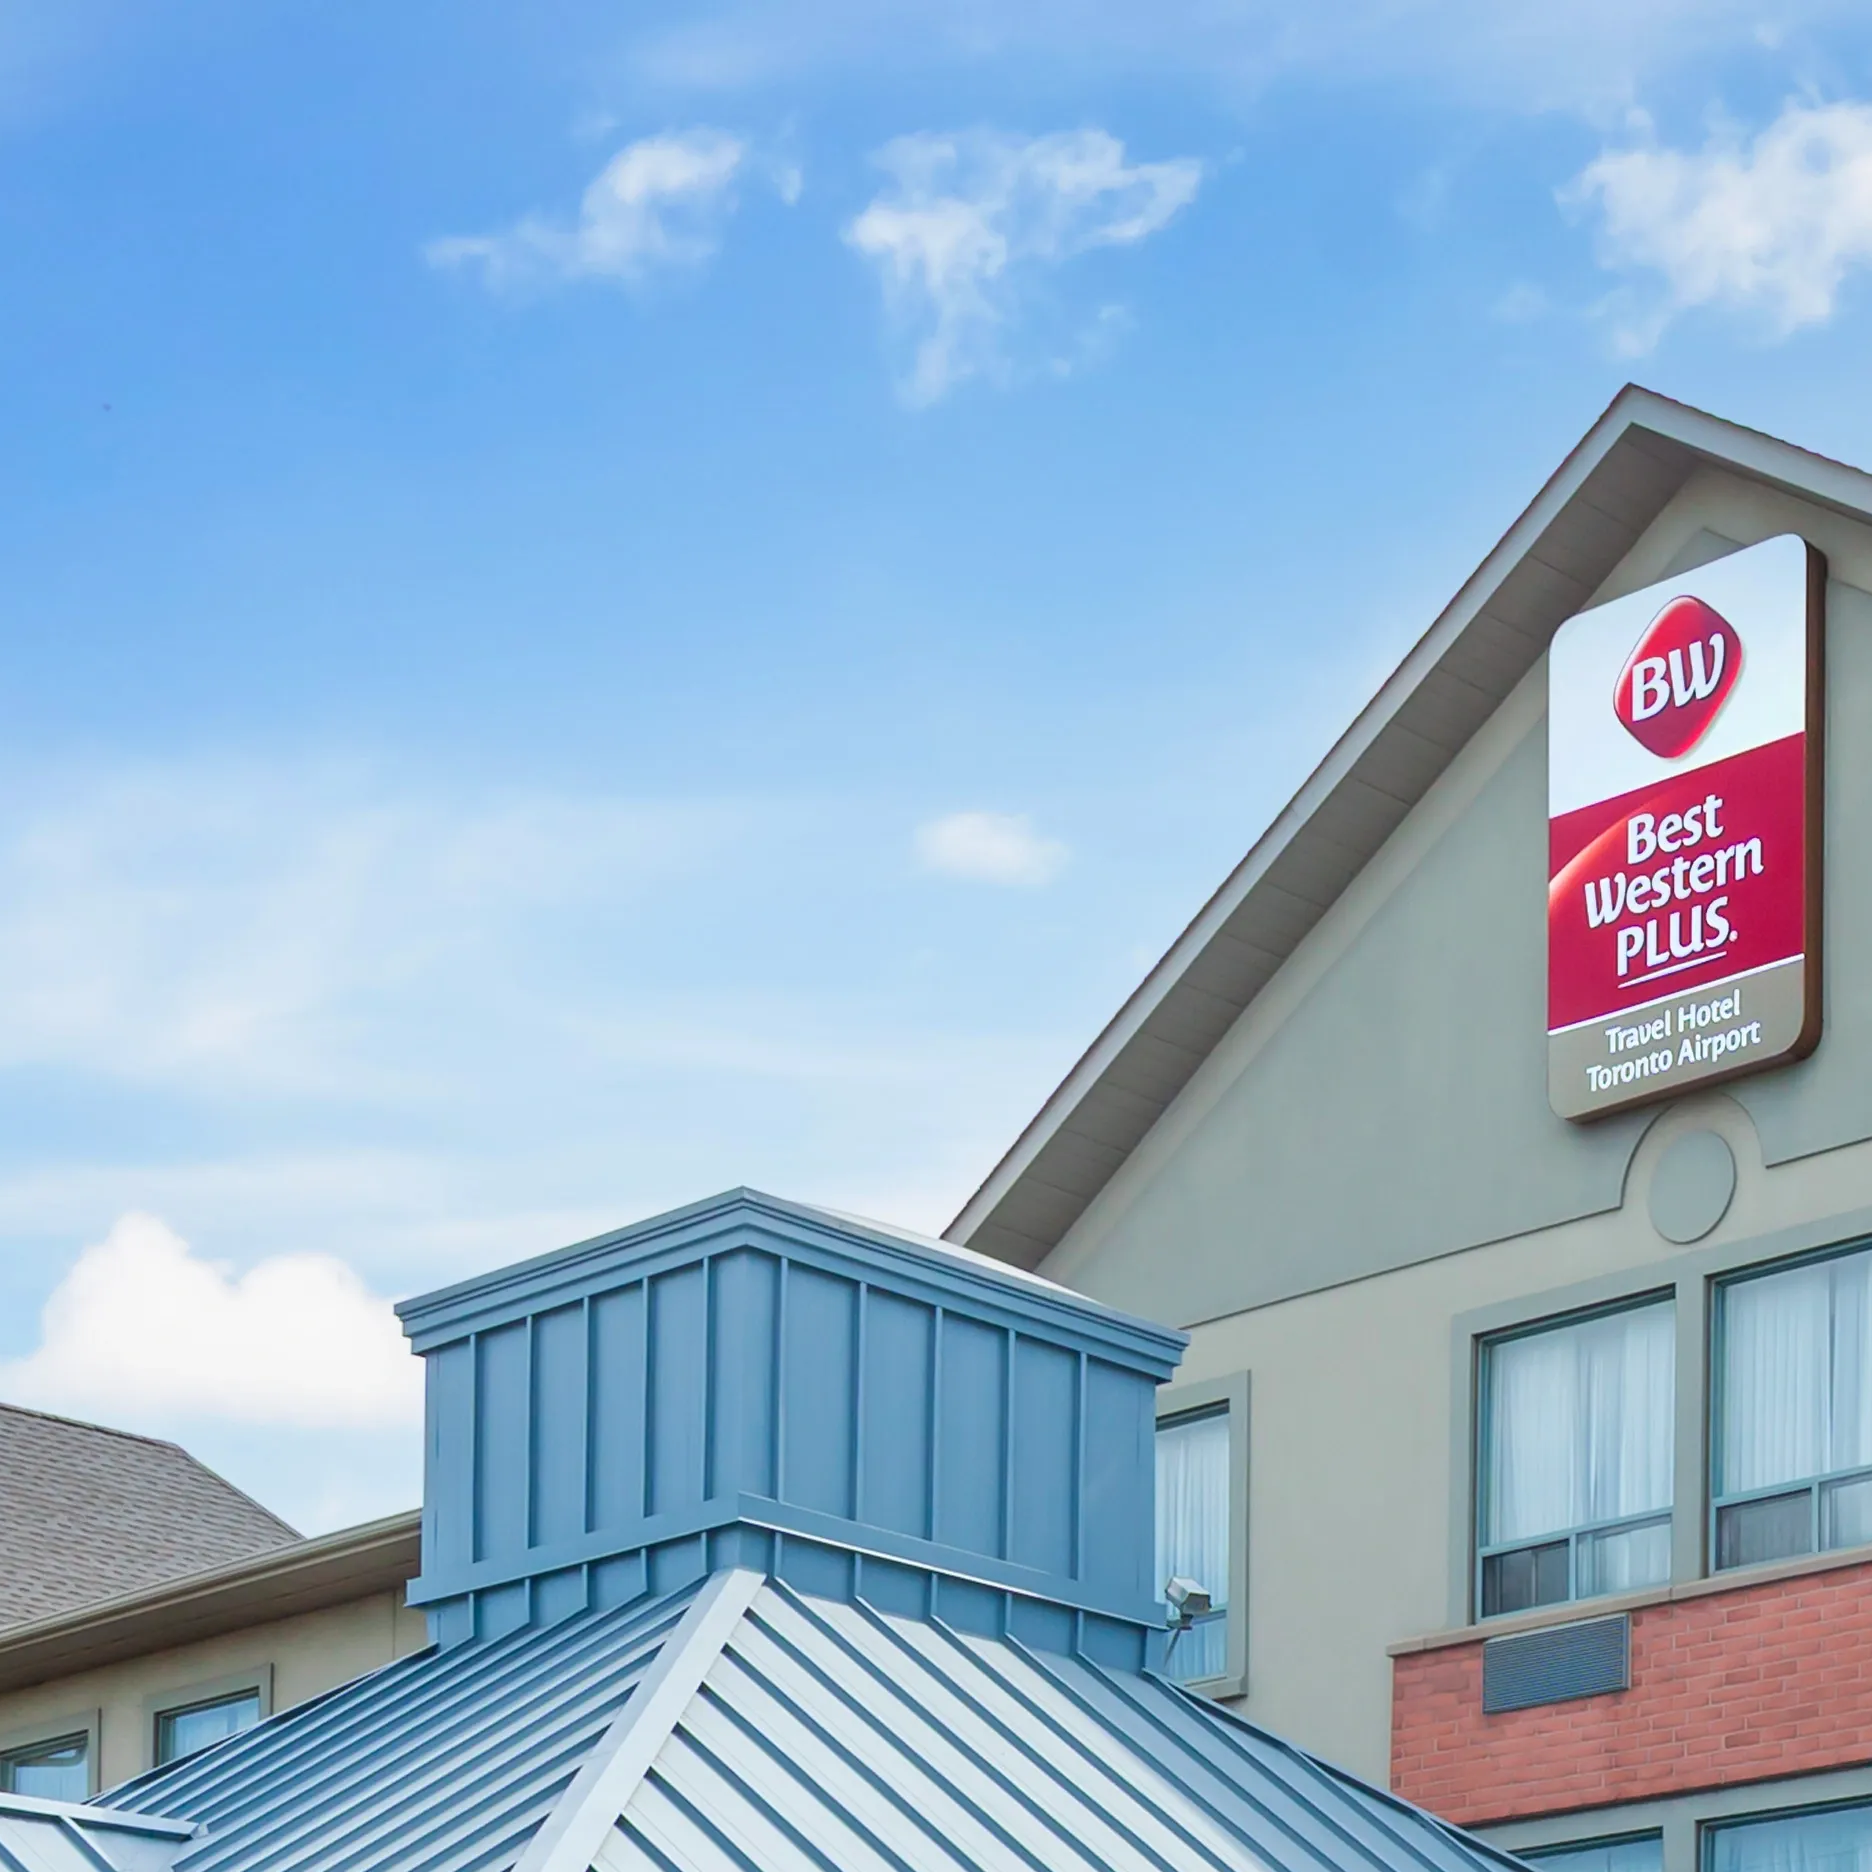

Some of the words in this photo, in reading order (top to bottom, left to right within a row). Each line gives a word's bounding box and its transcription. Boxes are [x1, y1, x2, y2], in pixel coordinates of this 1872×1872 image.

[1632, 632, 1726, 723] BW
[1627, 793, 1724, 866] Best
[1583, 836, 1764, 928] Western
[1586, 1049, 1673, 1093] Toronto
[1677, 1020, 1761, 1066] Airport
[1605, 1009, 1672, 1054] Travel
[1678, 988, 1741, 1033] Hotel
